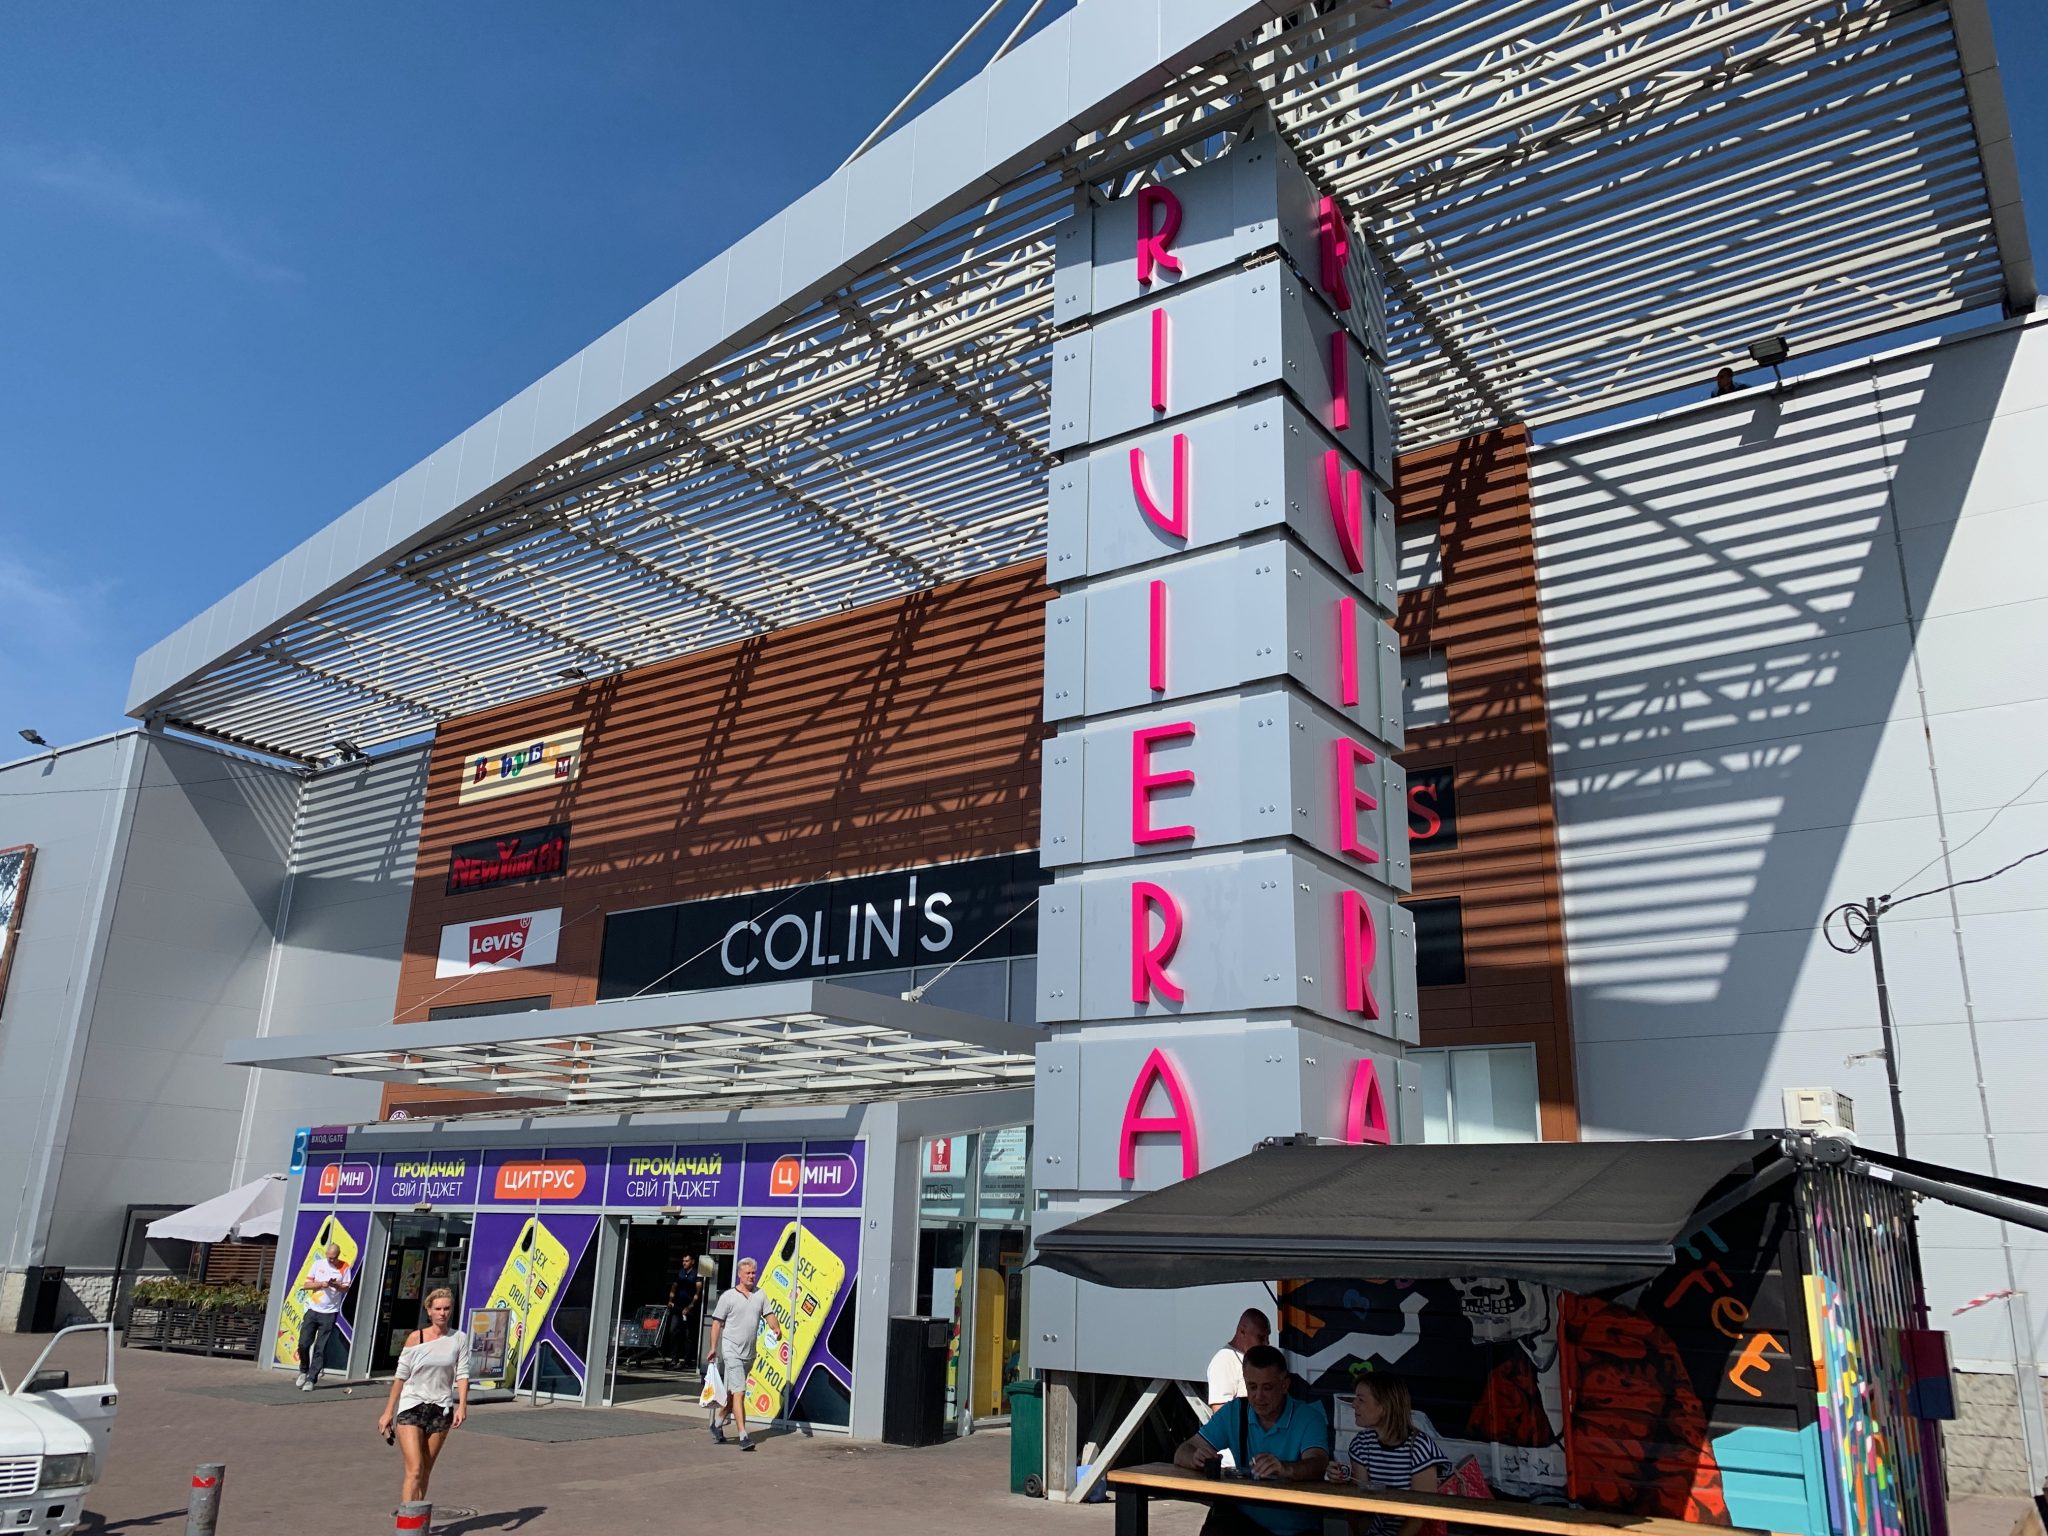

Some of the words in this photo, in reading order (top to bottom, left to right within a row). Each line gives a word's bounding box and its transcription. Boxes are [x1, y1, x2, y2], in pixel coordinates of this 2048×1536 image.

[1319, 196, 1391, 1144] RIVIERA
[1118, 185, 1199, 1181] RIVIERA
[451, 856, 499, 889] NEW
[496, 837, 564, 879] YORKER
[720, 875, 953, 976] COLIN'S
[291, 1132, 307, 1171] 3
[938, 1155, 943, 1164] 2
[393, 1158, 466, 1178] ПРОКАЧАЙ
[628, 1153, 722, 1176] ПРОКАЧАЙ
[778, 1167, 793, 1186] Ц
[804, 1165, 842, 1184] МІНІ
[325, 1174, 335, 1188] Ц
[340, 1171, 364, 1187] МІНІ
[391, 1180, 417, 1197] СВІЙ
[418, 1181, 463, 1199] ГАДЖЕТ
[504, 1169, 575, 1191] ЦИТРУС
[626, 1178, 659, 1198] СВІЙ
[662, 1180, 720, 1200] ГАДЖЕТ
[532, 1248, 549, 1270] SEX
[797, 1255, 817, 1283] SEX
[508, 1283, 532, 1316] DRUGS
[769, 1298, 800, 1336] DRUGS
[756, 1353, 786, 1397] 'N'ROLL
